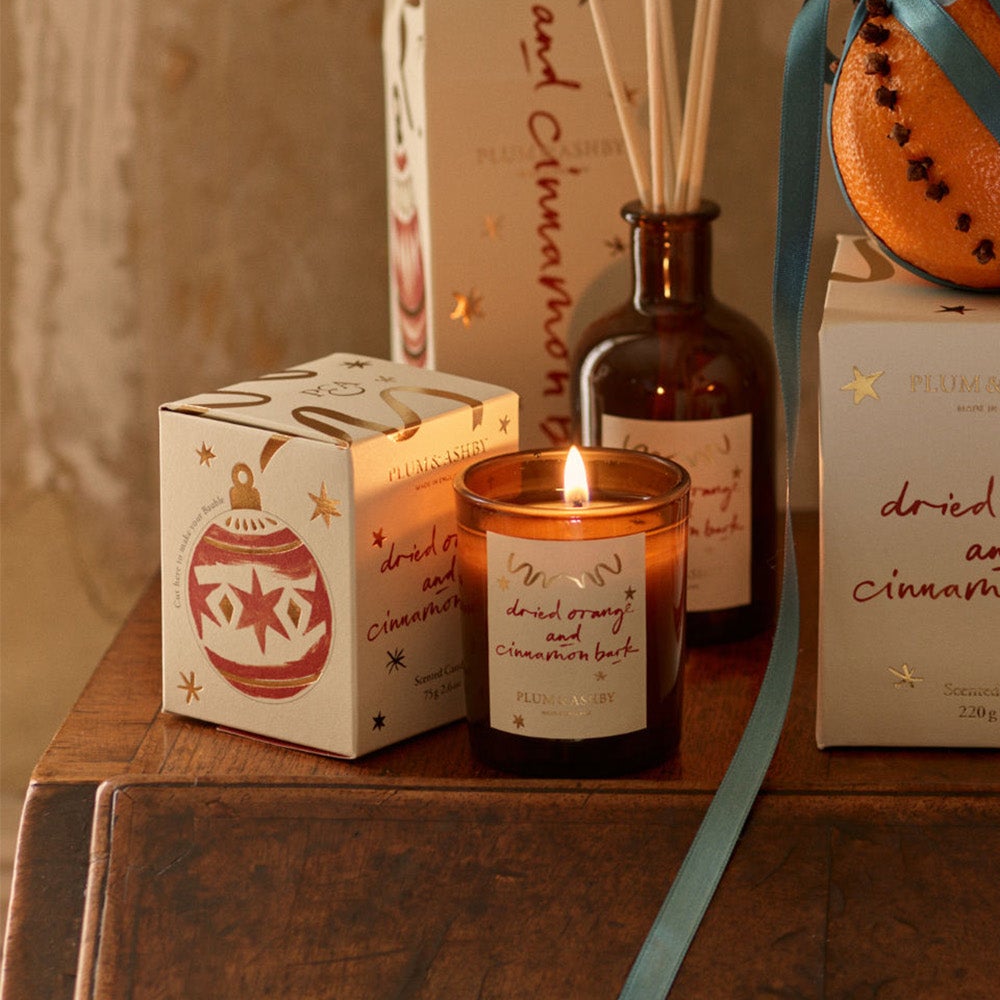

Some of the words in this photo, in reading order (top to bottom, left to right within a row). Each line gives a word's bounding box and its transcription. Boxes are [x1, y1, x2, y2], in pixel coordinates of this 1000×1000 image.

[520, 4, 580, 91] and
[909, 374, 981, 394] PLUM
[957, 404, 983, 413] MADE
[880, 475, 996, 519] dried
[380, 524, 437, 574] dried
[422, 555, 457, 595] and
[506, 599, 562, 622] dried
[567, 602, 635, 635] orange
[495, 643, 590, 664] cinnamon
[594, 638, 640, 666] bark
[546, 624, 581, 649] and
[943, 682, 1000, 697] Scented
